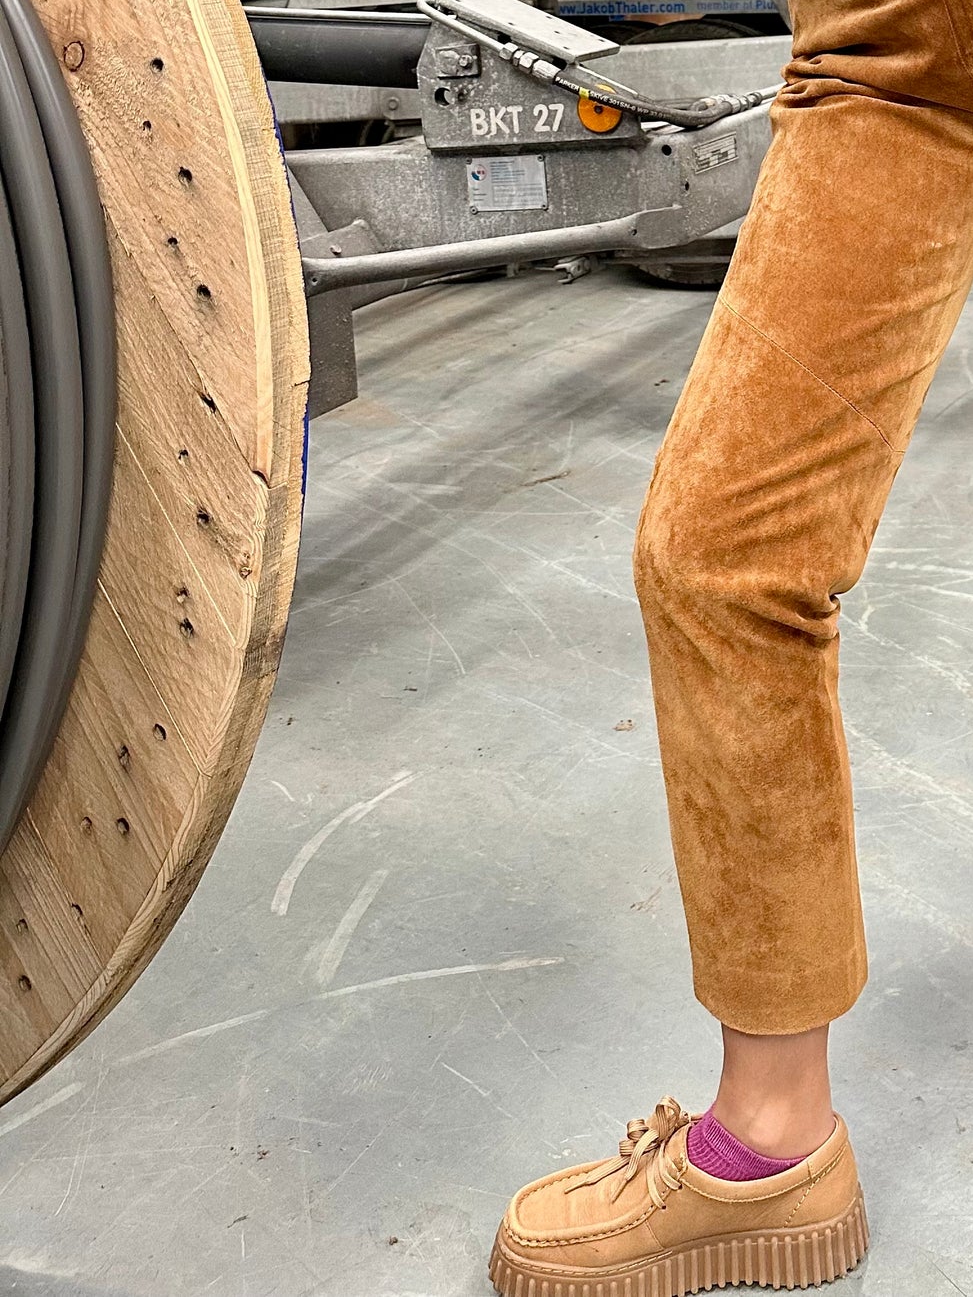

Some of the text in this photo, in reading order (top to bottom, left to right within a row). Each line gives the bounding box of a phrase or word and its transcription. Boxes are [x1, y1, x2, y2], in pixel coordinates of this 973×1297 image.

[560, 1, 685, 14] ww.JakobThaler.com
[554, 76, 580, 92] PARKER
[470, 103, 564, 136] BKT 27
